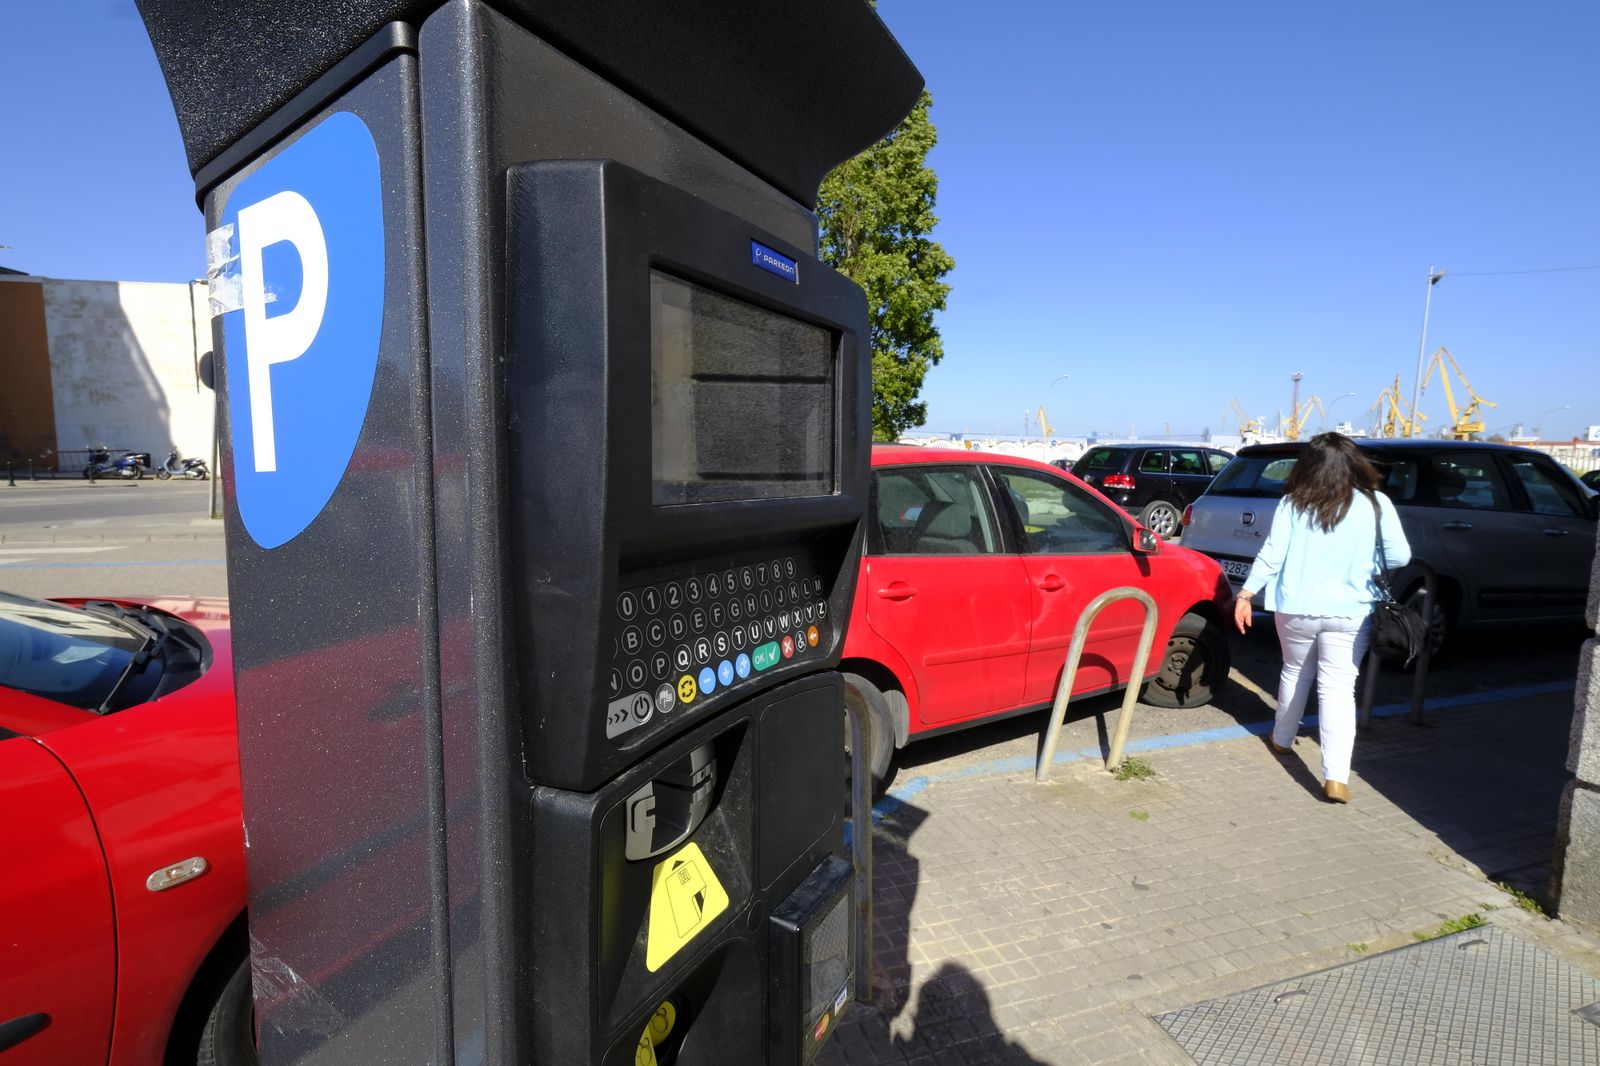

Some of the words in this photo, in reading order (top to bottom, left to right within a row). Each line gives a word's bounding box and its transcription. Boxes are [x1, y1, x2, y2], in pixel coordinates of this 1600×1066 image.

[763, 254, 795, 275] PARKEON
[238, 190, 329, 473] P
[622, 596, 633, 616] 0
[647, 591, 655, 610] 1
[669, 586, 679, 605] 2
[690, 582, 699, 599] 3
[709, 577, 718, 594] 4
[727, 574, 735, 590] 5
[743, 570, 751, 586] 6
[758, 567, 765, 582] 7
[773, 563, 780, 579] 8
[786, 560, 793, 575] 9
[1223, 561, 1249, 576] 3282
[627, 632, 638, 649] B
[651, 625, 661, 641] C
[673, 619, 683, 635] D
[694, 613, 703, 629] E
[713, 607, 721, 623] F
[731, 602, 740, 617] G
[747, 598, 755, 612] H
[764, 594, 769, 607] I
[778, 590, 783, 603] J
[790, 586, 798, 599] K
[803, 583, 810, 595] L
[814, 579, 822, 591] M
[631, 665, 643, 683] O
[656, 657, 665, 674] P
[677, 650, 689, 666] Q
[698, 643, 709, 659] R
[717, 636, 726, 652] S
[734, 630, 742, 645] T
[751, 625, 759, 639] U
[766, 620, 773, 633] V
[779, 615, 788, 629] W
[793, 610, 801, 624] X
[806, 606, 812, 618] Y
[818, 602, 825, 615] Z
[754, 653, 765, 665] OK
